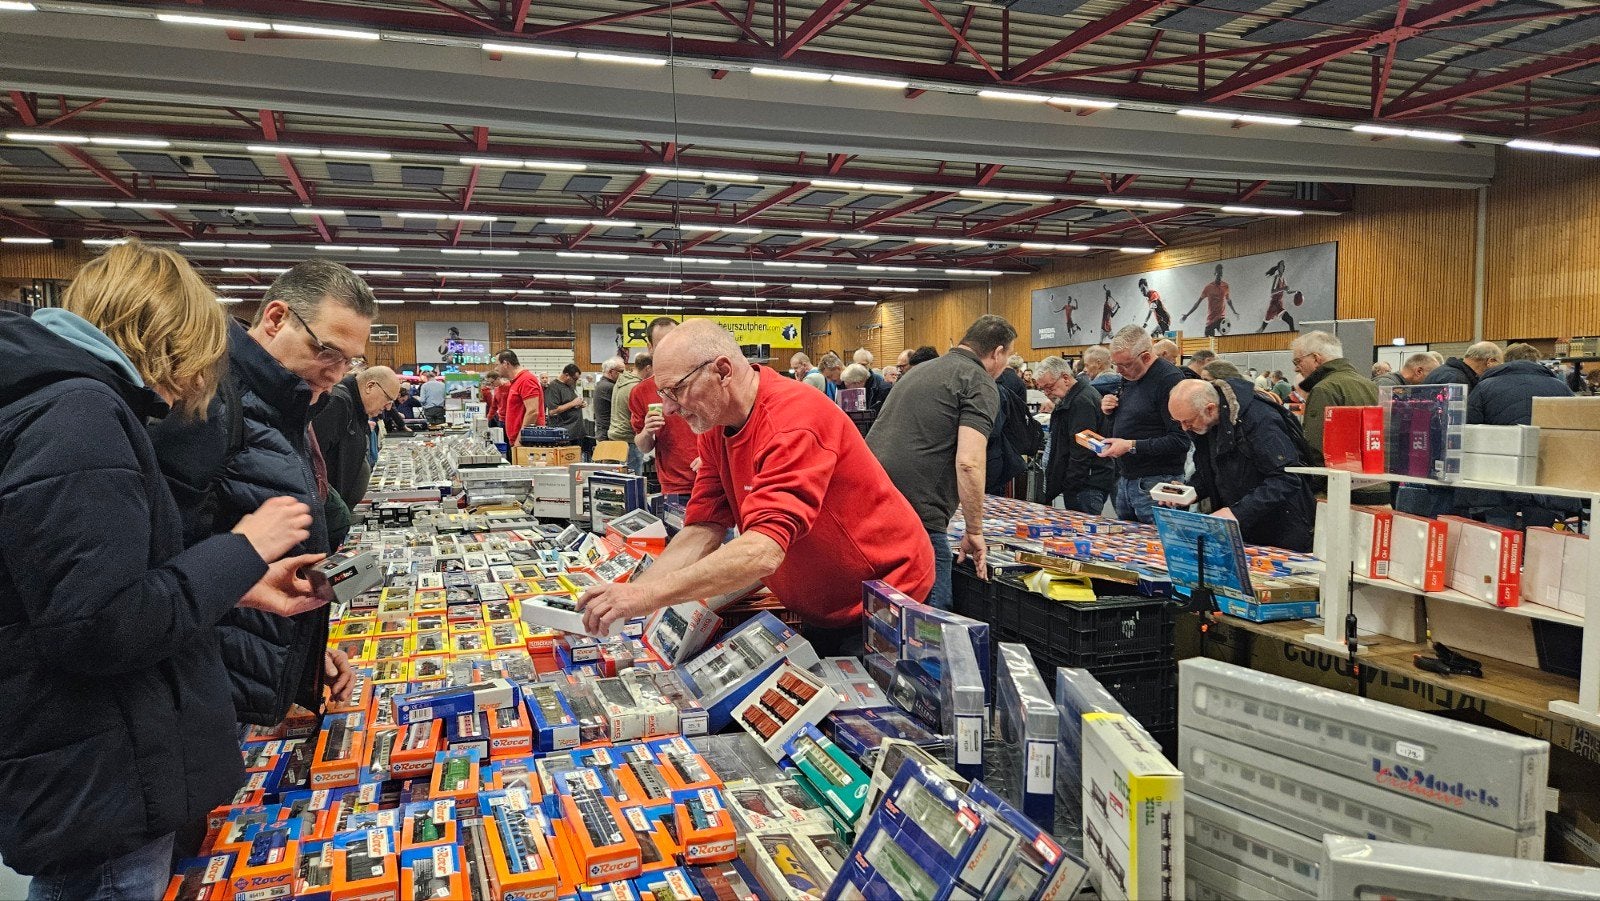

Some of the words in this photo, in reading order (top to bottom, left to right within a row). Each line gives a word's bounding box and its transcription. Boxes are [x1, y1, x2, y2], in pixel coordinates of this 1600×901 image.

[499, 738, 528, 747] Roco
[400, 762, 432, 771] Roco
[321, 772, 354, 780] Roco
[1146, 797, 1155, 825] TRIX
[698, 843, 734, 854] Roco
[968, 838, 989, 872] Roco
[600, 860, 637, 872] Roco
[251, 874, 291, 886] Roco
